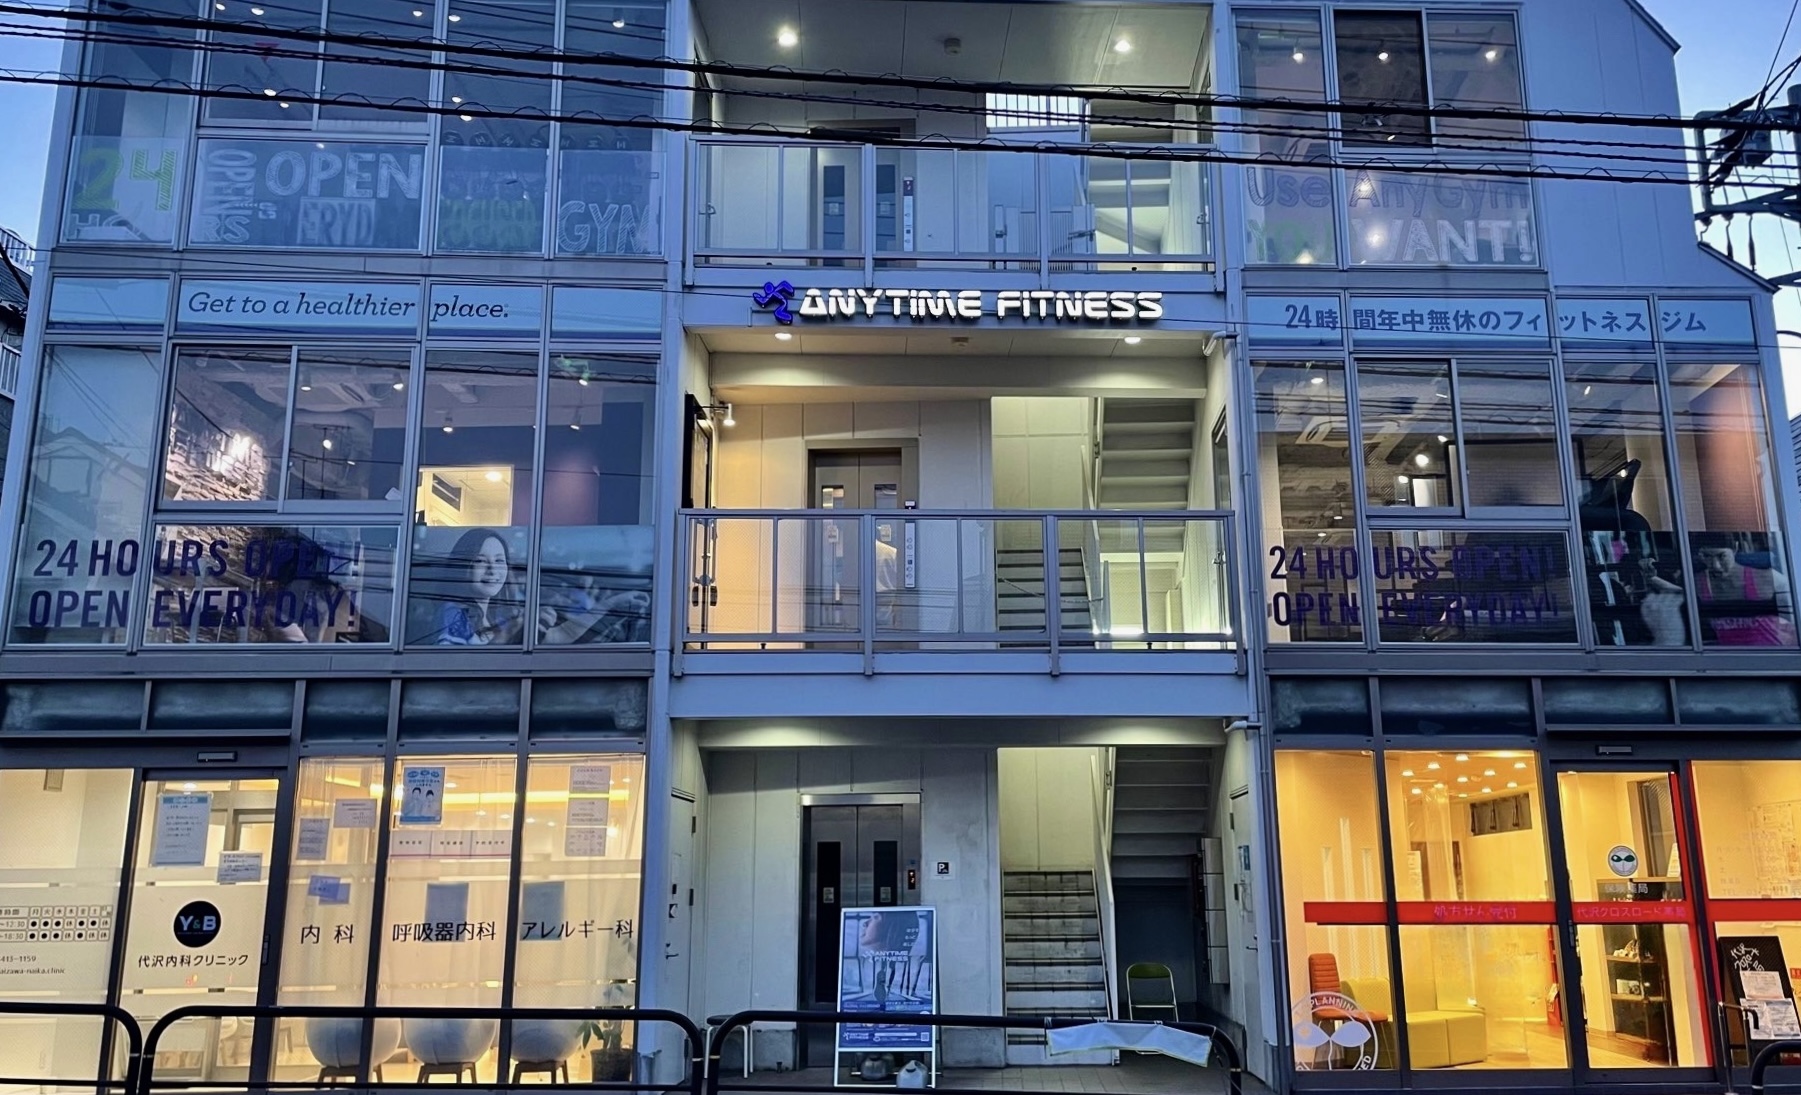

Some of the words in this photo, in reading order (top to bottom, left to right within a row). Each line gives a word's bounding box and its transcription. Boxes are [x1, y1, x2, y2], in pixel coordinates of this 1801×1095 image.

[70, 147, 176, 212] 24
[265, 150, 422, 199] OPEN
[1246, 166, 1331, 208] Use
[1350, 168, 1429, 217] Any
[557, 200, 663, 252] GYM
[188, 292, 234, 313] Get
[241, 296, 266, 313] to
[273, 300, 290, 313] a
[295, 292, 415, 315] healthier
[800, 288, 982, 318] ANYTIME
[997, 290, 1163, 320] FITNESS
[33, 539, 78, 577] 24
[88, 539, 229, 577] HOURS
[245, 540, 361, 577] OPE!
[1269, 545, 1307, 580] 24
[1316, 546, 1439, 580] HOURS
[28, 590, 130, 628] OPEN
[152, 590, 358, 628] EVERYDAY!
[1272, 592, 1361, 626] OPEN
[938, 863, 946, 873] P
[179, 915, 217, 931] Y&B
[392, 921, 497, 942] 呼吸器内科
[521, 919, 635, 940] アレルギー科
[138, 954, 249, 968] 代沢内科クリニック
